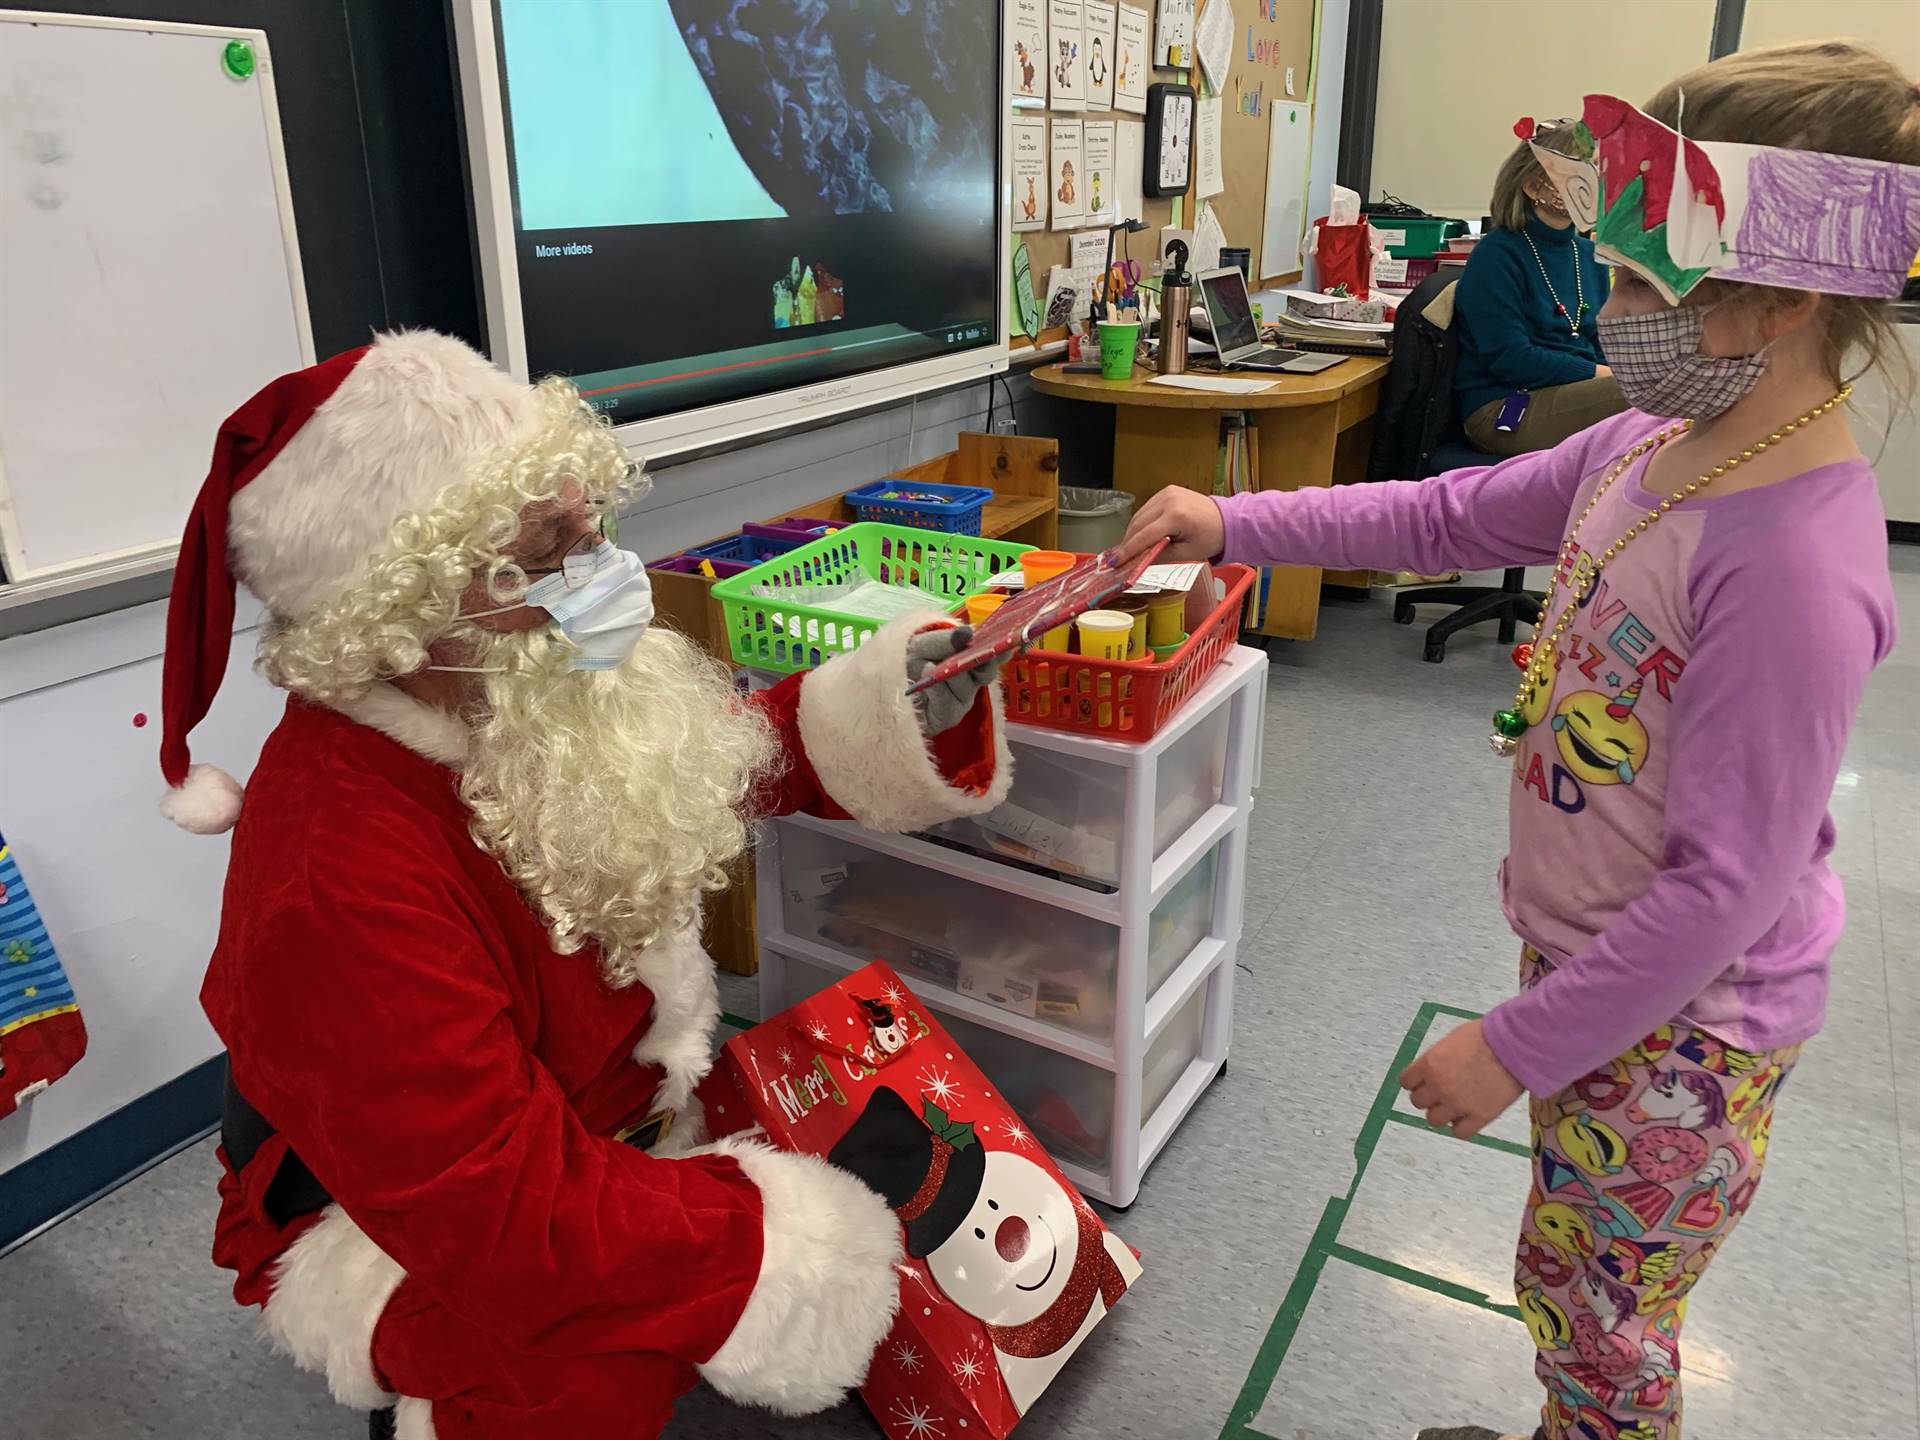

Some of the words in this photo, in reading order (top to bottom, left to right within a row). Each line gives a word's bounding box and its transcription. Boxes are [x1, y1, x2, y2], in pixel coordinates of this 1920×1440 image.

[535, 244, 561, 258] More
[562, 242, 593, 255] videos
[940, 572, 966, 596] 12
[769, 1055, 848, 1124] Merry
